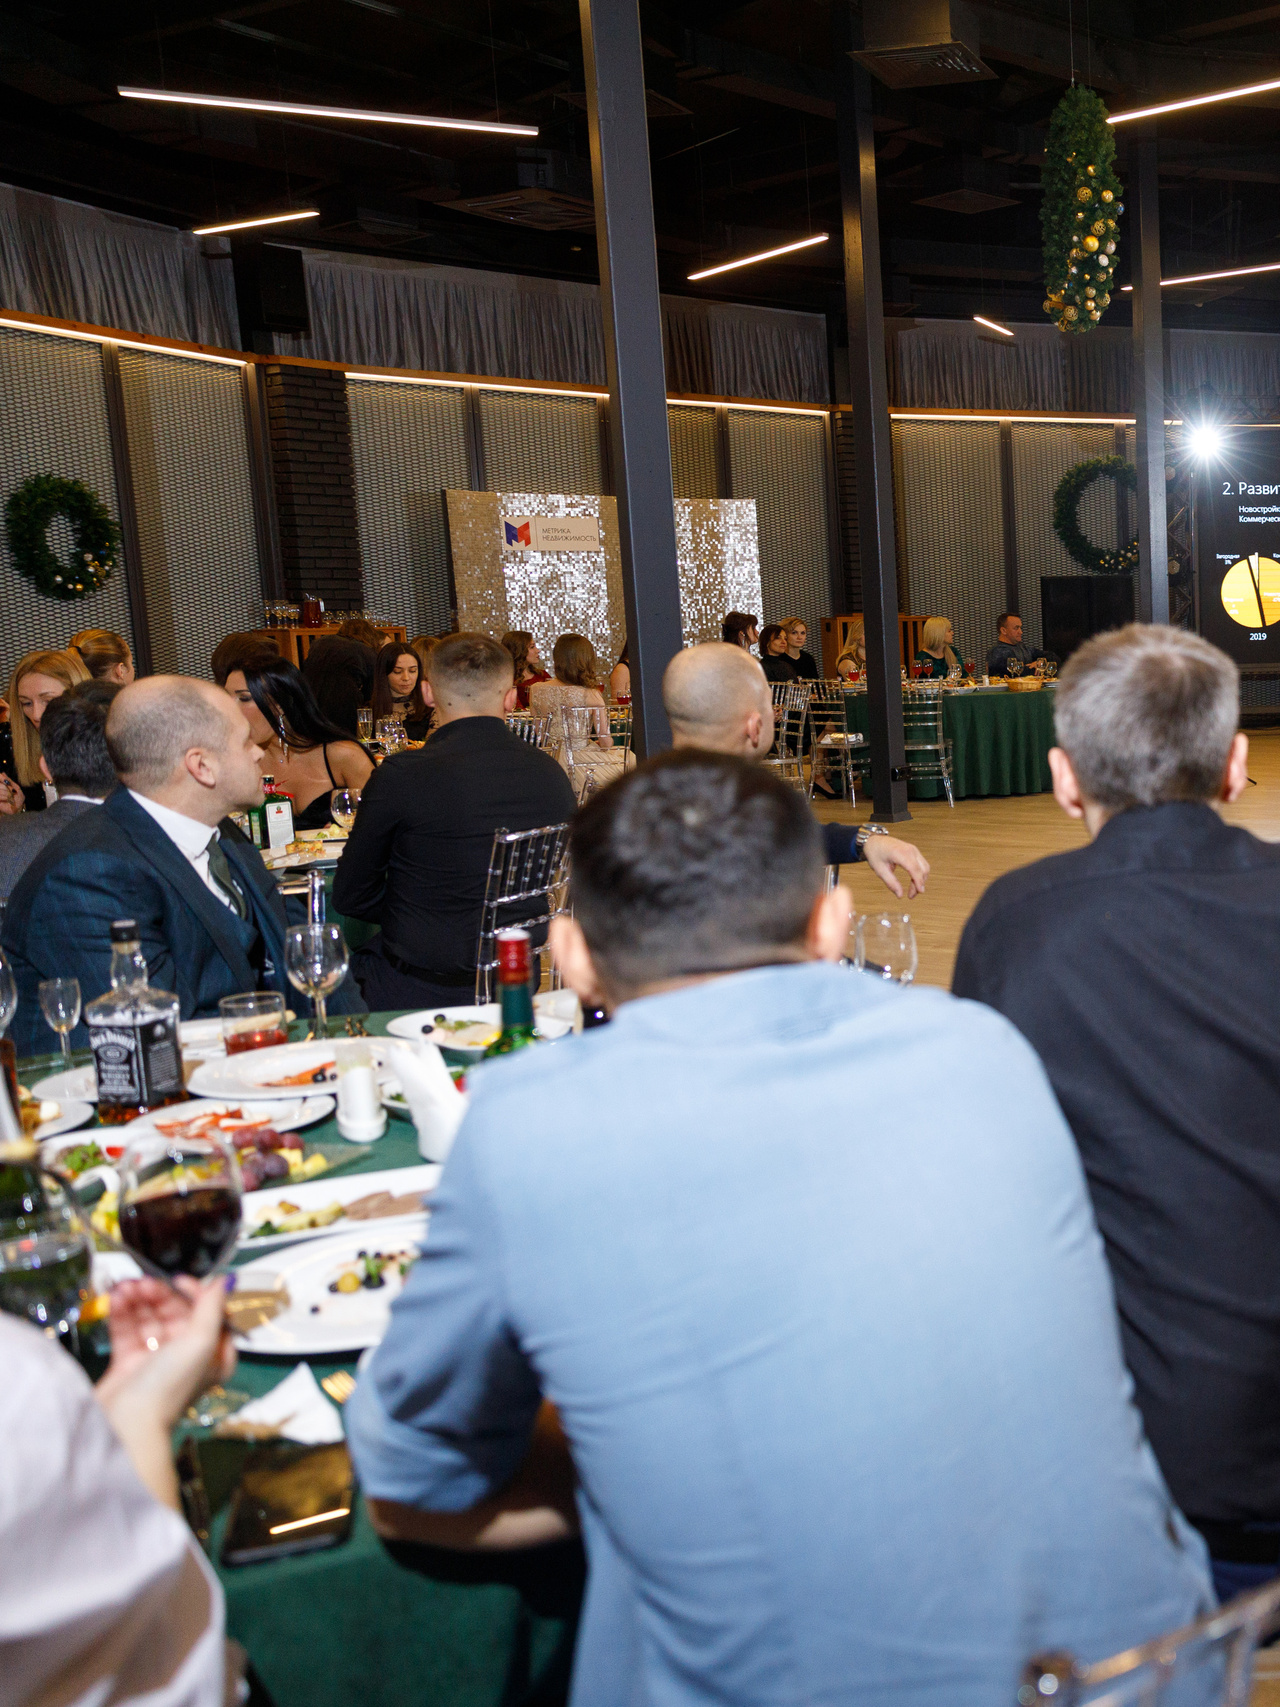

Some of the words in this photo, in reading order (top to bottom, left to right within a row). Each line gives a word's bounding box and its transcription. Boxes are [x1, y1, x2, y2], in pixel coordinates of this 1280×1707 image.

[1222, 481, 1235, 495] 2.
[542, 534, 597, 542] НЕДВИЖИМОСТЬ
[1249, 632, 1267, 640] 2019
